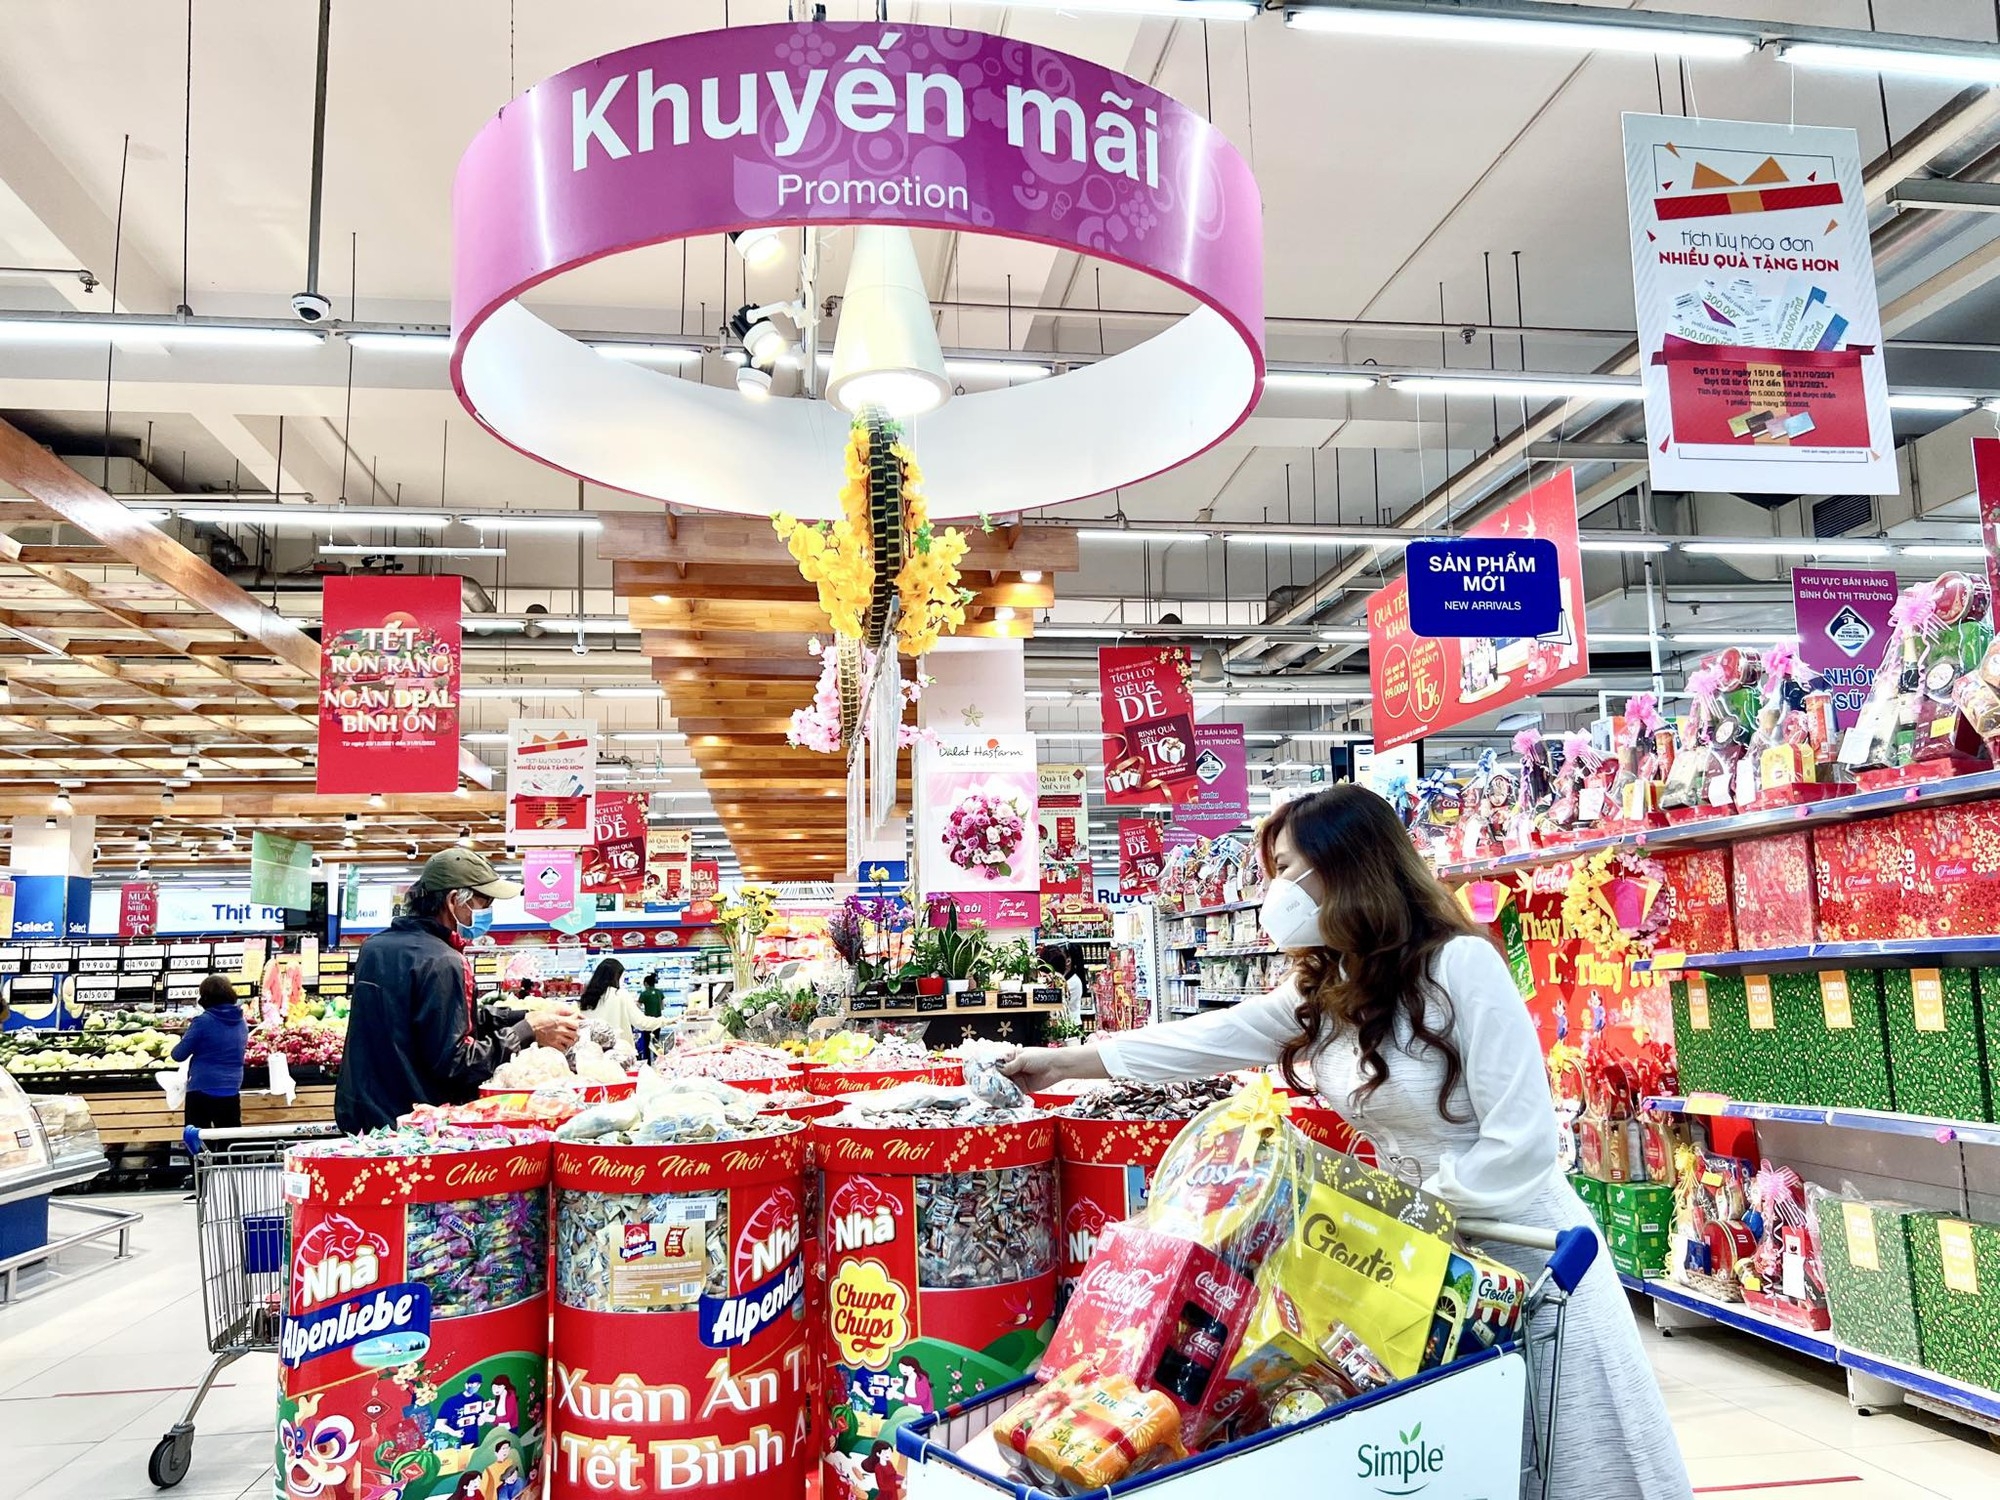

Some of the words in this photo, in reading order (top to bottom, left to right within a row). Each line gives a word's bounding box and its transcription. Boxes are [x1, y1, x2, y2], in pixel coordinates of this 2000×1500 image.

[572, 32, 964, 171] Khuyến
[1006, 83, 1160, 189] mãi
[778, 174, 968, 210] Promotion
[1681, 230, 1711, 247] tích
[1659, 247, 1709, 266] NHIỀU
[1714, 252, 1749, 268] QUÀ
[1753, 254, 1797, 272] TẶNG
[1803, 259, 1839, 271] HƠN
[1429, 552, 1470, 572] SẢN
[1478, 551, 1536, 572] PHẨM
[1464, 574, 1505, 591] MỚI
[1801, 576, 1819, 585] KHU
[1821, 577, 1841, 586] VỰC
[1843, 576, 1860, 586] BÁN
[1863, 577, 1888, 586] HÀNG
[1444, 601, 1472, 610] NEW
[1475, 601, 1521, 611] ARRIVALS
[1800, 589, 1820, 599] BÌNH
[1837, 592, 1852, 602] THỊ
[1854, 592, 1892, 600] TRƯỜNG
[362, 620, 420, 650] TẾT
[1110, 672, 1134, 683] TÍCH
[395, 690, 456, 708] DEAL
[1114, 682, 1144, 697] SIÊU
[1415, 673, 1440, 713] 15%
[341, 711, 398, 732] BÌNH
[1138, 728, 1157, 738] RINH
[1157, 723, 1176, 735] QUÀ
[974, 745, 1023, 759] Hasfarm
[1040, 774, 1056, 783] Quà
[1059, 774, 1070, 782] Tết
[596, 806, 609, 814] ÍCH
[691, 869, 712, 880] SIÊU
[127, 913, 149, 921] GIẢM
[212, 904, 250, 923] Thịt
[14, 921, 54, 933] Select
[69, 922, 86, 933] Select
[835, 1077, 871, 1091] Mừng
[1296, 1117, 1329, 1139] Năm
[837, 1137, 874, 1160] Năm
[883, 1138, 935, 1161] Mới
[446, 1161, 498, 1188] Chúc
[557, 1152, 582, 1177] Chúc
[587, 1154, 647, 1187] Mừng
[657, 1154, 712, 1179] Năm
[721, 1149, 769, 1172] Mới
[449, 1218, 476, 1239] mento
[836, 1205, 895, 1252] Nhà
[1069, 1229, 1098, 1264] Nh
[302, 1244, 379, 1307] Nhà
[712, 1251, 804, 1346] Alpenlieb
[837, 1283, 896, 1316] Chupa
[282, 1291, 413, 1370] Alpenliebe
[835, 1309, 893, 1352] Chups
[556, 1365, 686, 1423] Xuân
[562, 1434, 641, 1491] Tết
[657, 1427, 783, 1491] Bình
[1358, 1441, 1443, 1483] Simple
